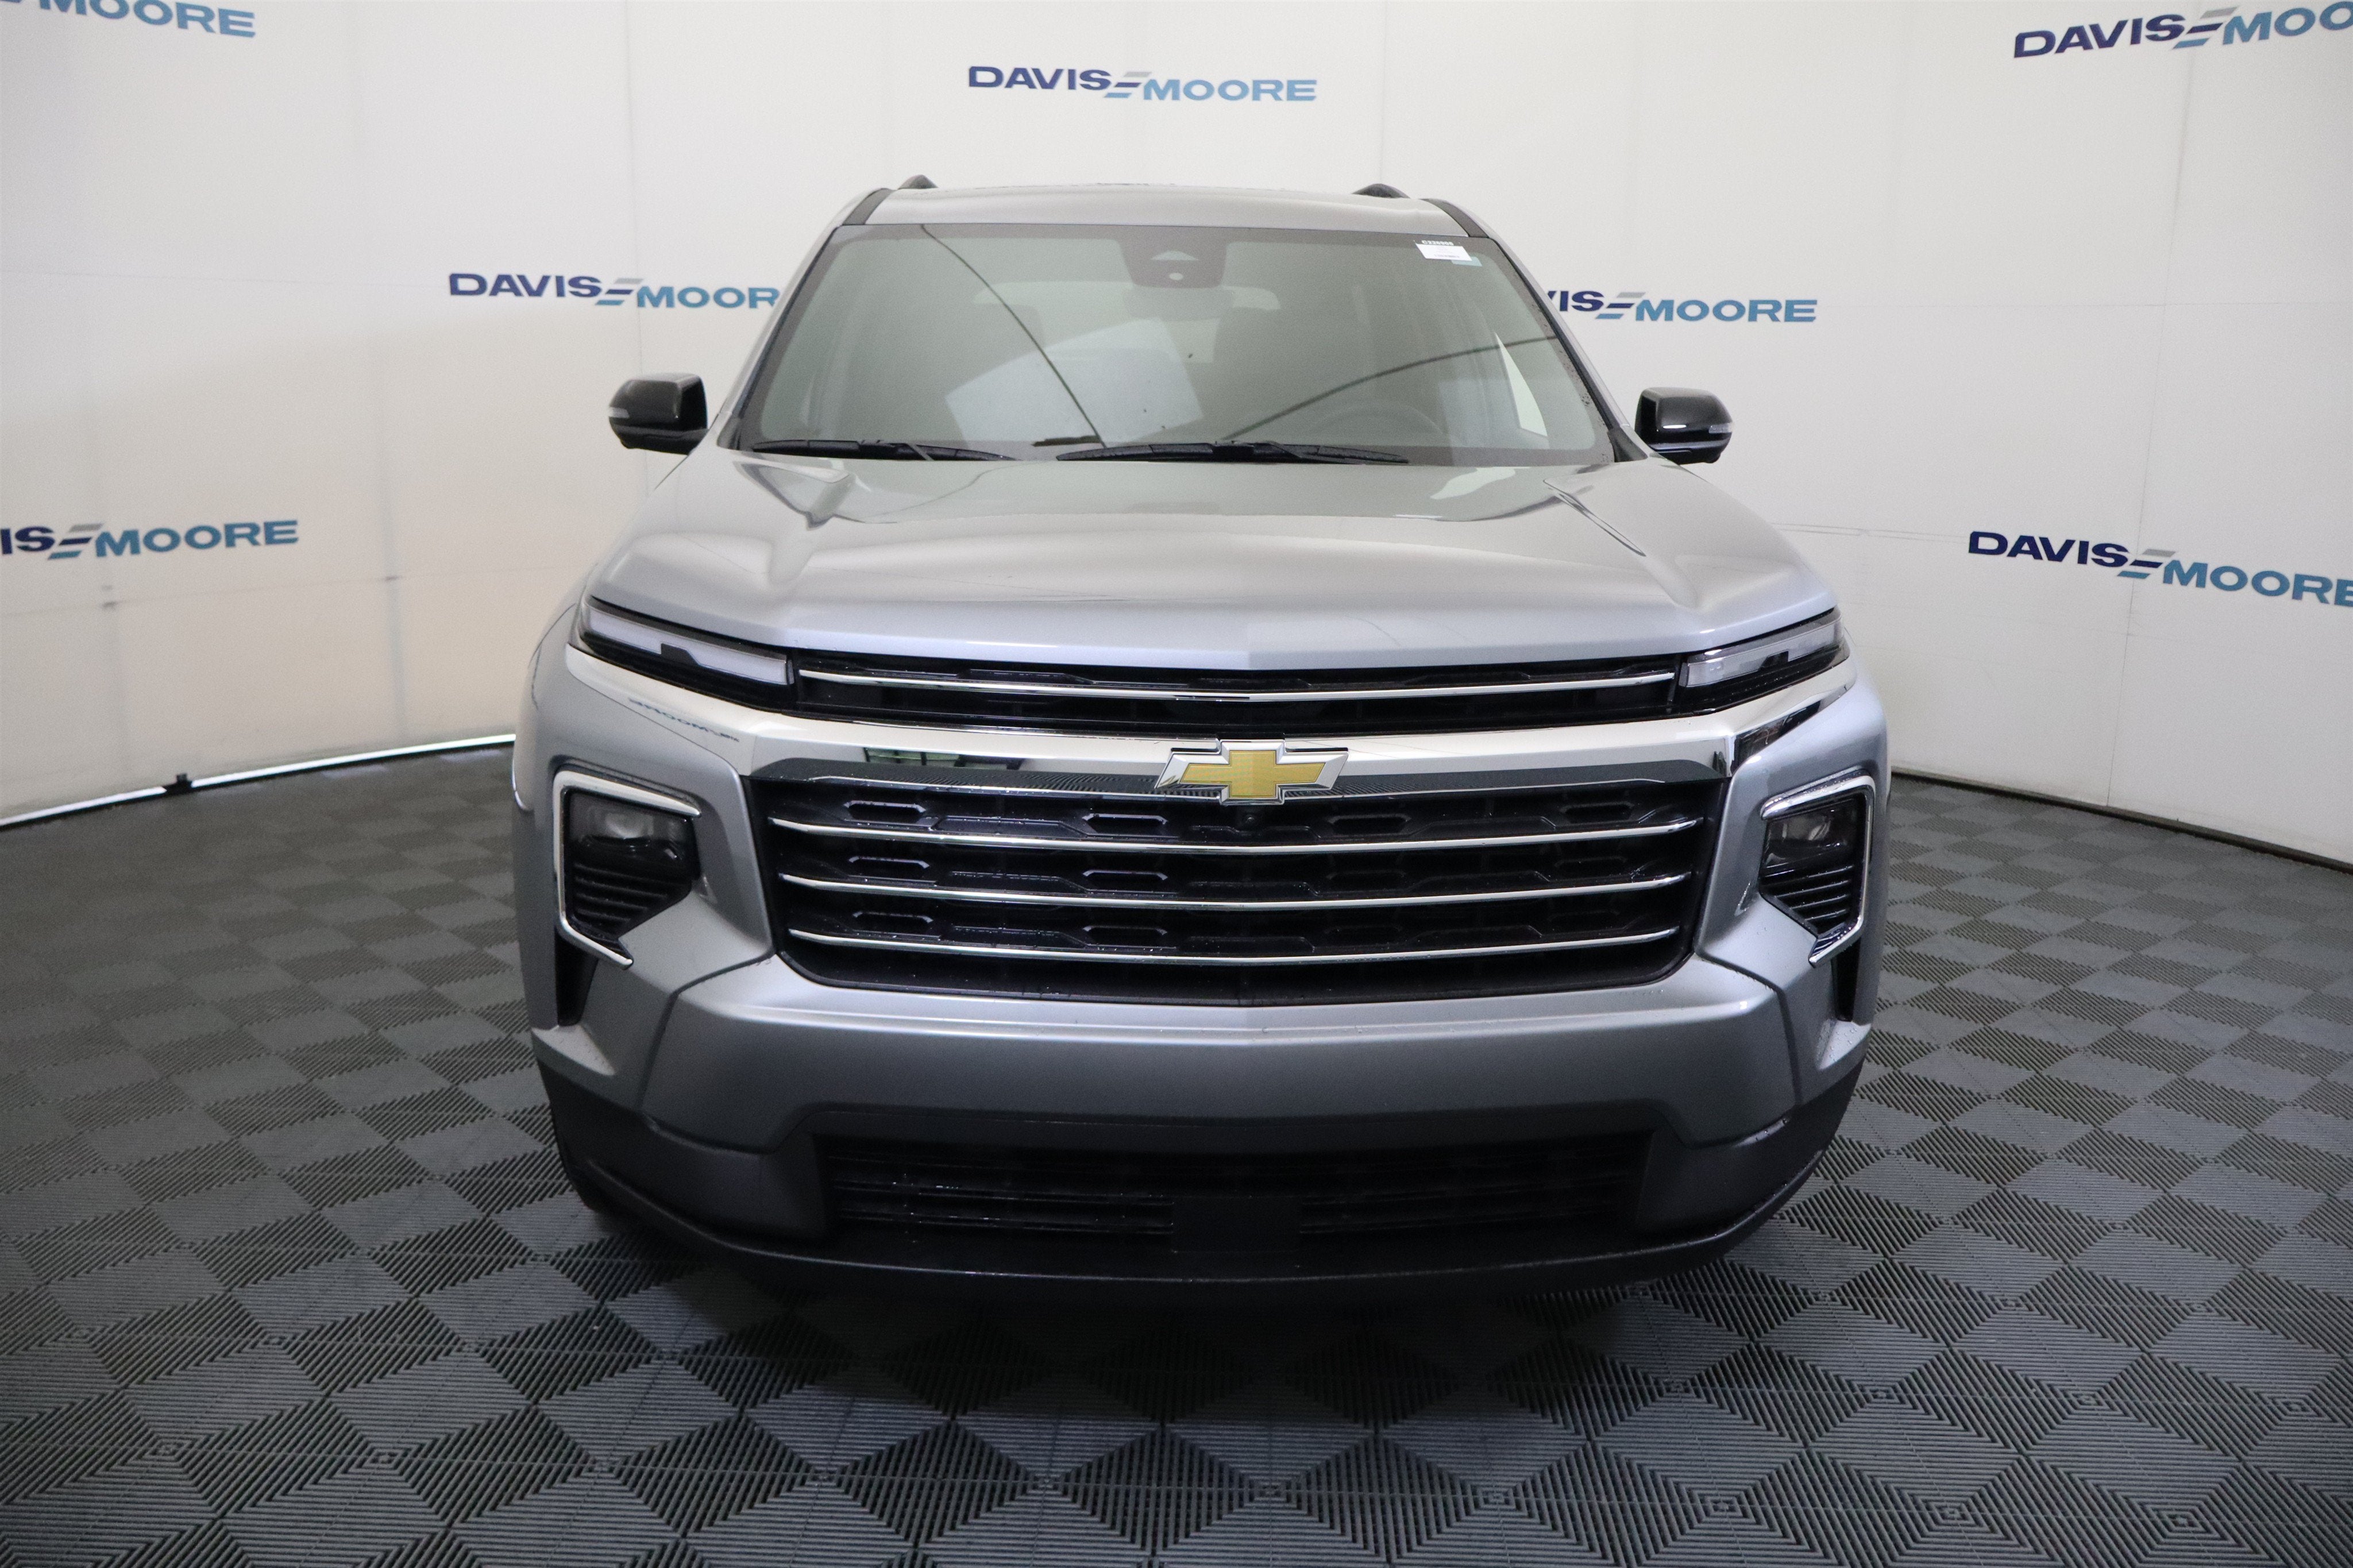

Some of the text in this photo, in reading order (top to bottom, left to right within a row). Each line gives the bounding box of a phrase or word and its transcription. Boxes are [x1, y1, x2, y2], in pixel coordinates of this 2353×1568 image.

[2013, 1, 2353, 58] DAVIS MOO
[969, 66, 1317, 101] DAVIS MOORE
[449, 273, 780, 308] DAVIS MOOR
[1635, 299, 1818, 322] MOORE
[95, 520, 299, 558] MOORE
[1968, 531, 2129, 568] DAVIS
